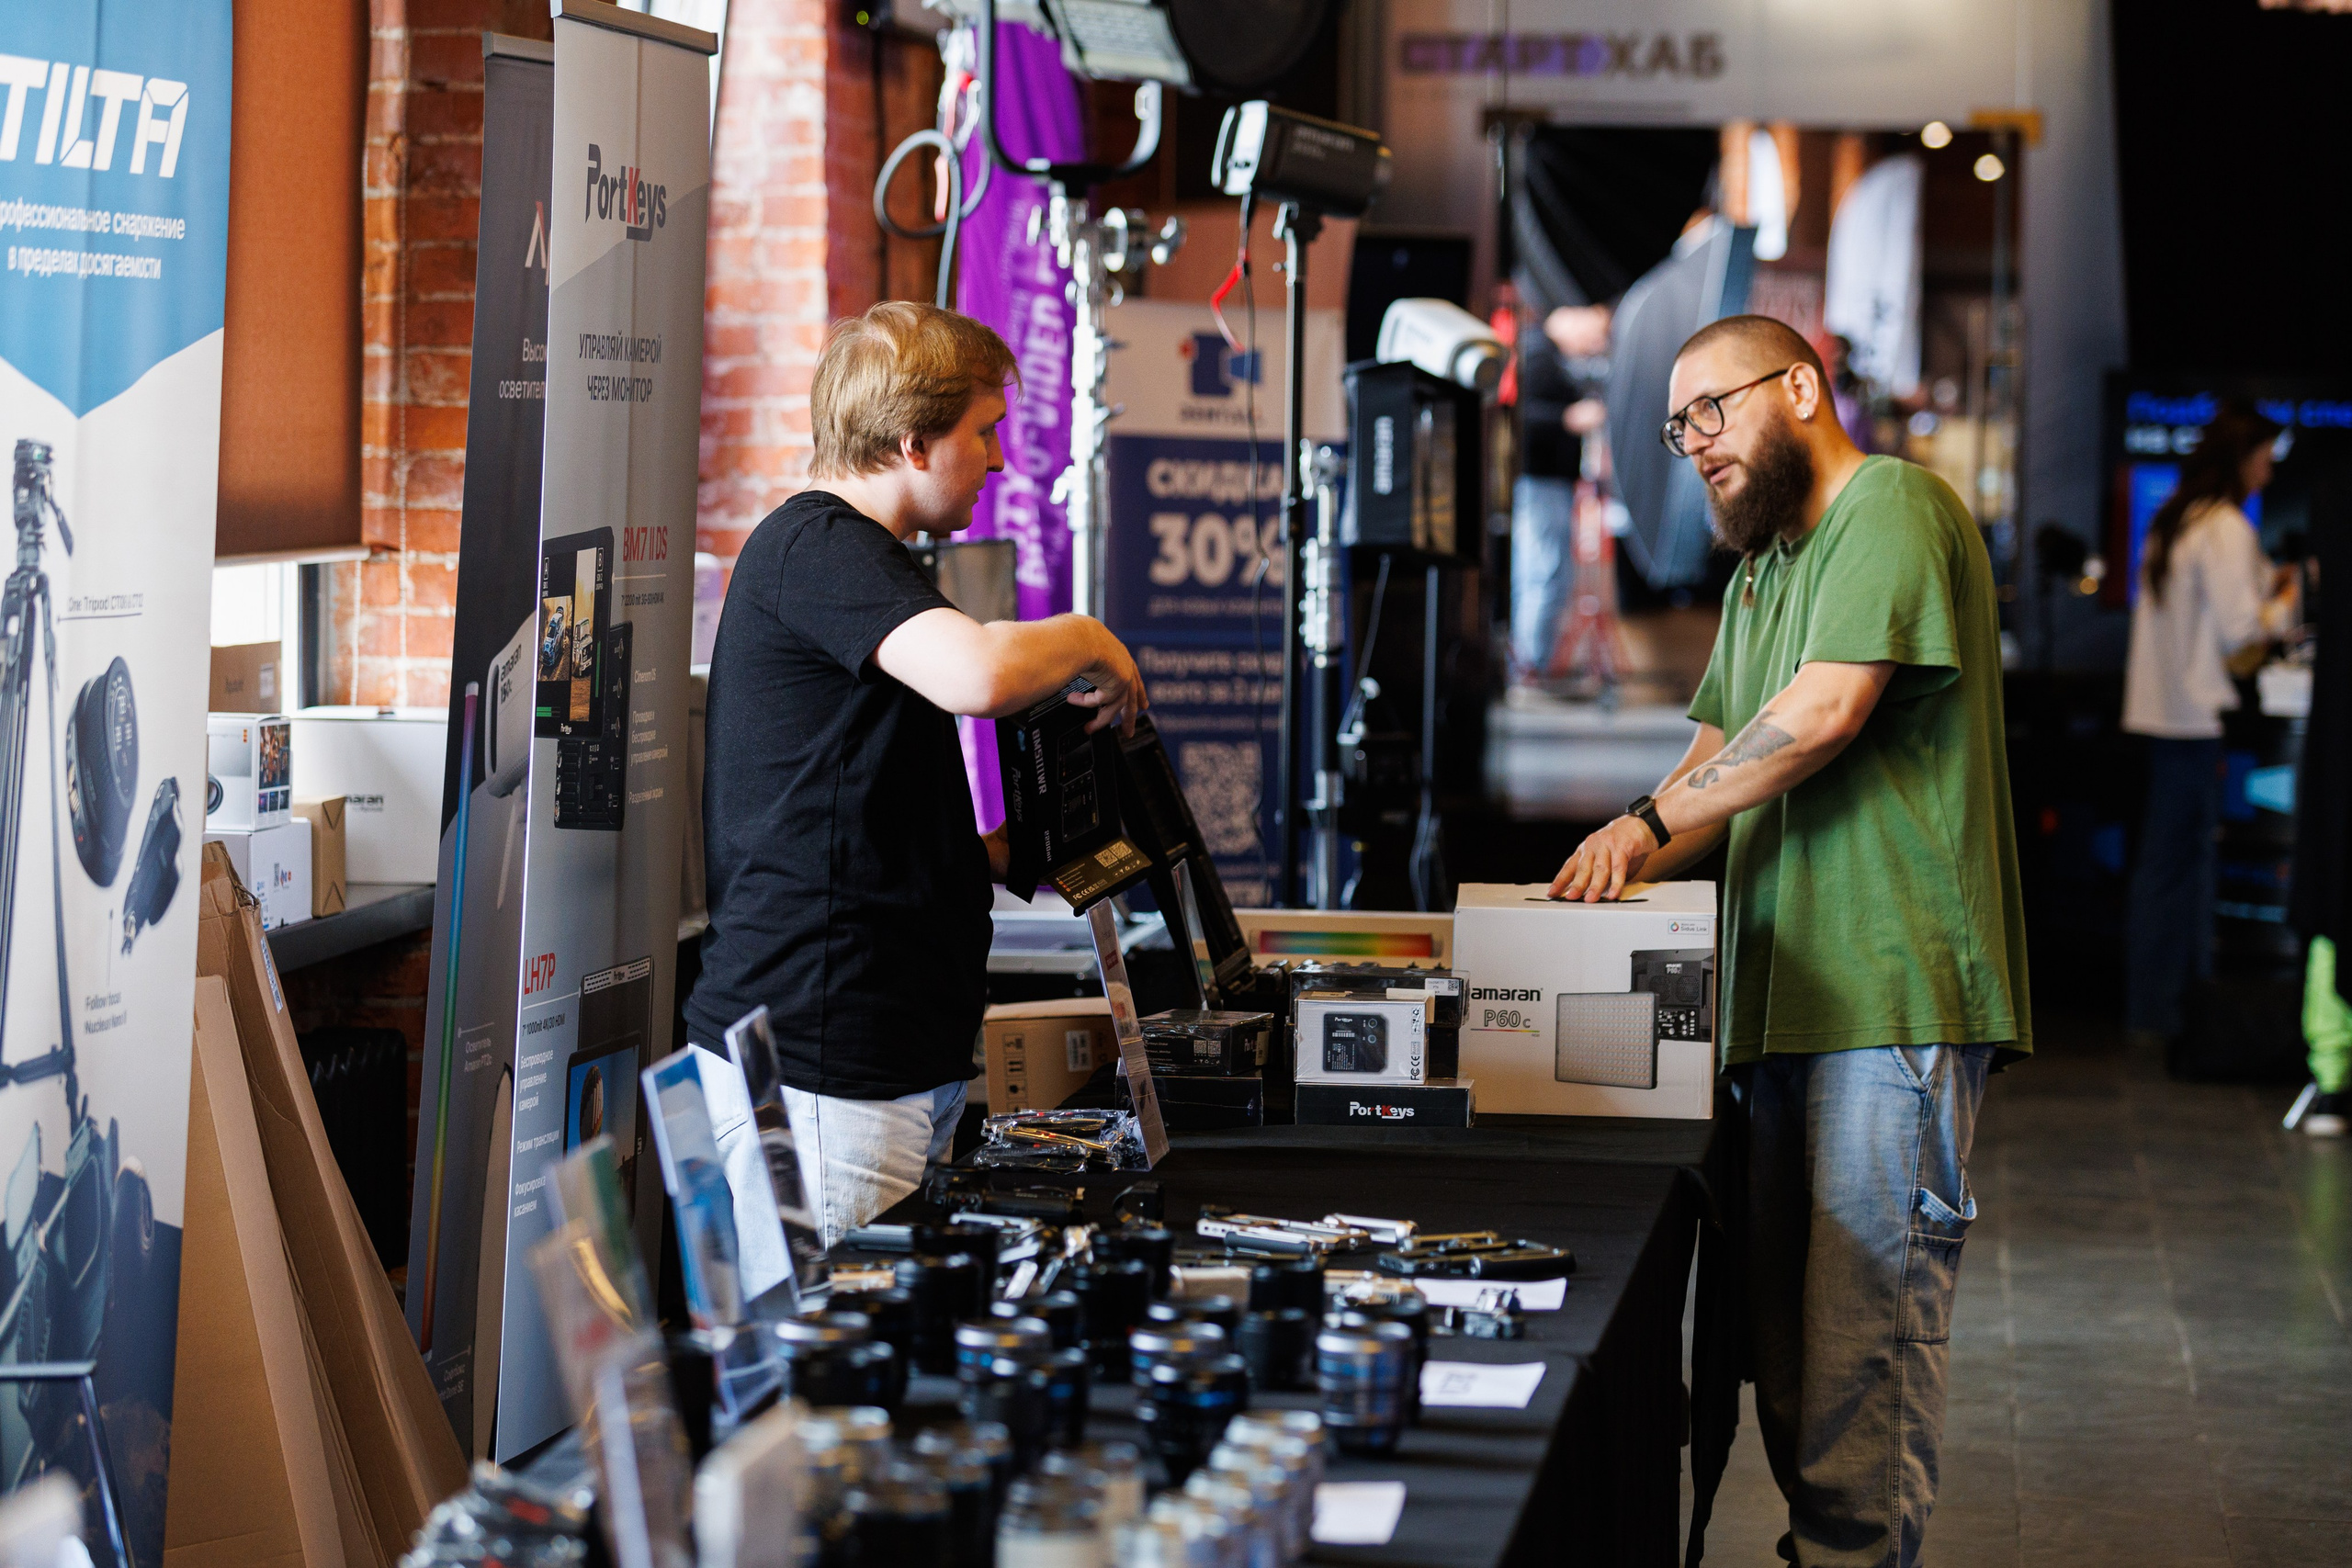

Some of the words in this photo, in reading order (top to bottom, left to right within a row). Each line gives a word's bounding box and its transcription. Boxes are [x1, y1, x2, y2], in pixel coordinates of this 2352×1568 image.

[0, 53, 189, 178] TILTA
[584, 143, 667, 242] PortKeys
[0, 197, 111, 233] рофессиональное
[113, 212, 186, 242] снаряжение
[7, 245, 17, 271] в
[17, 246, 79, 277] пределах
[78, 252, 162, 280] досягаемости
[523, 338, 547, 362] Высо
[579, 330, 624, 361] УПРАВЛЯЙ
[625, 333, 662, 364] КАМЕРОЙ
[499, 380, 546, 400] осветител
[588, 375, 610, 401] ЧЕРЕЗ
[611, 376, 653, 402] МОНИТОР
[623, 526, 648, 561] BM7
[655, 525, 668, 561] DS
[1150, 511, 1285, 588] 30%
[84, 595, 109, 613] Tripod
[344, 794, 384, 805] maran
[1011, 766, 1024, 823] PortKeys
[524, 952, 556, 996] LH7P
[1471, 987, 1541, 1001] amaran
[520, 1049, 554, 1069] Беспроводное
[519, 1072, 548, 1093] управление
[518, 1091, 539, 1111] камерой
[1349, 1101, 1415, 1120] PortKeys
[516, 1139, 533, 1155] Режим
[533, 1129, 560, 1150] трансляции
